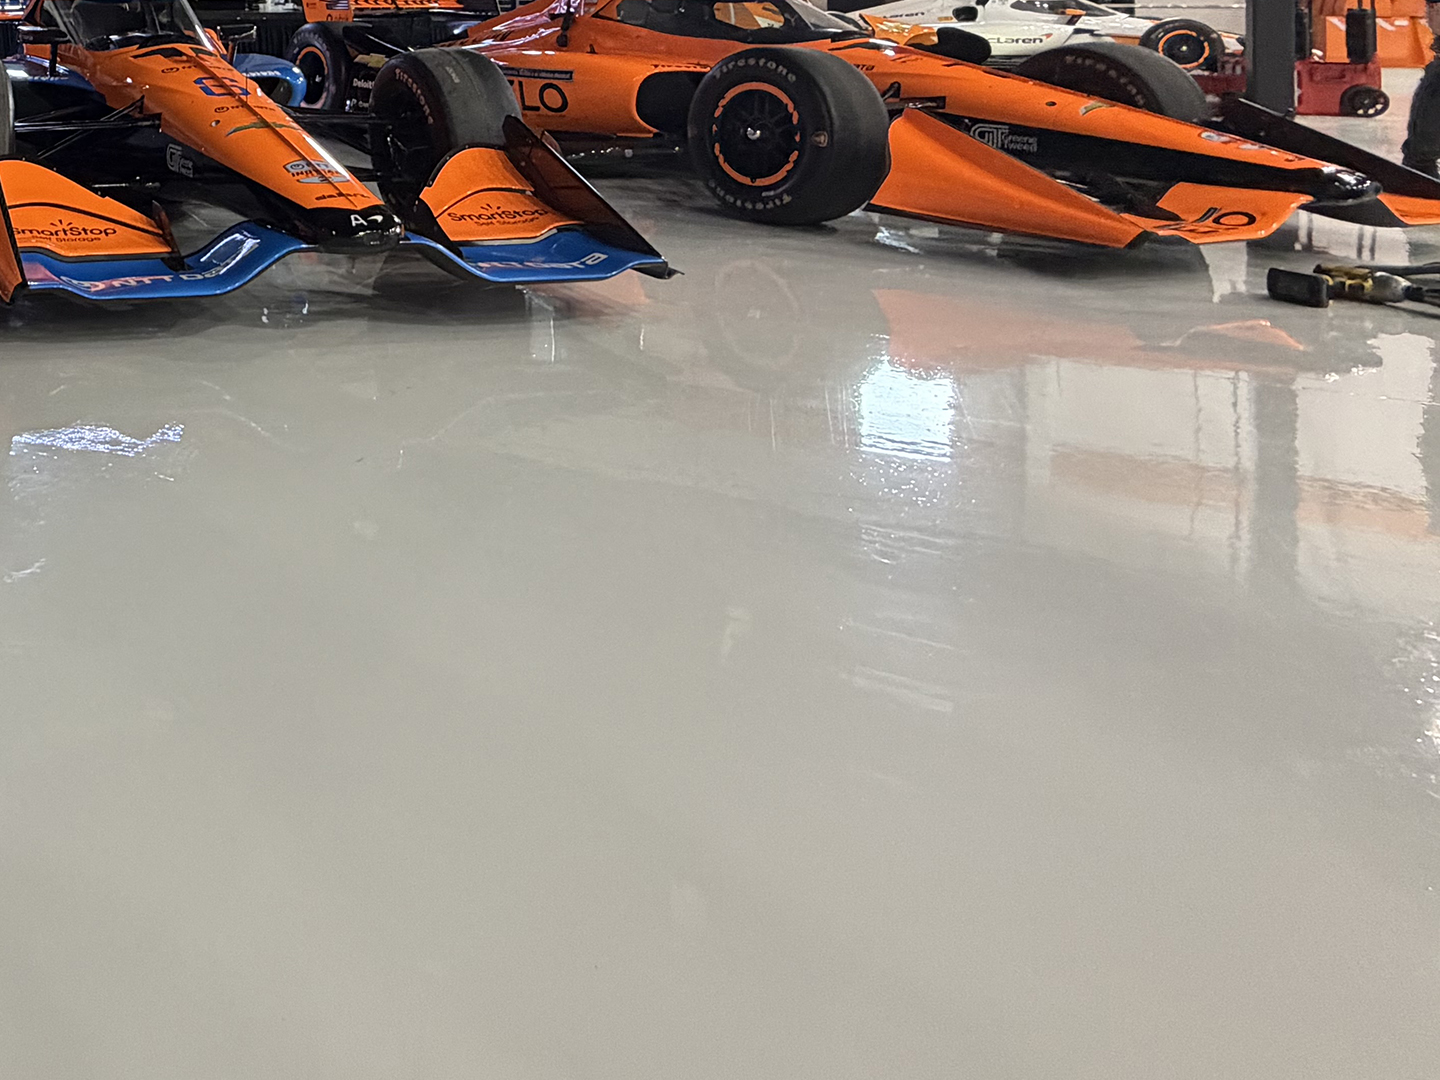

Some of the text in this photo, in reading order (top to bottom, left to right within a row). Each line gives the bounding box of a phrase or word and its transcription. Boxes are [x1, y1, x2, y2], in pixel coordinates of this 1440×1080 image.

[447, 209, 549, 222] SmartStop
[13, 226, 117, 237] SmartStop
[111, 274, 174, 288] NTT
